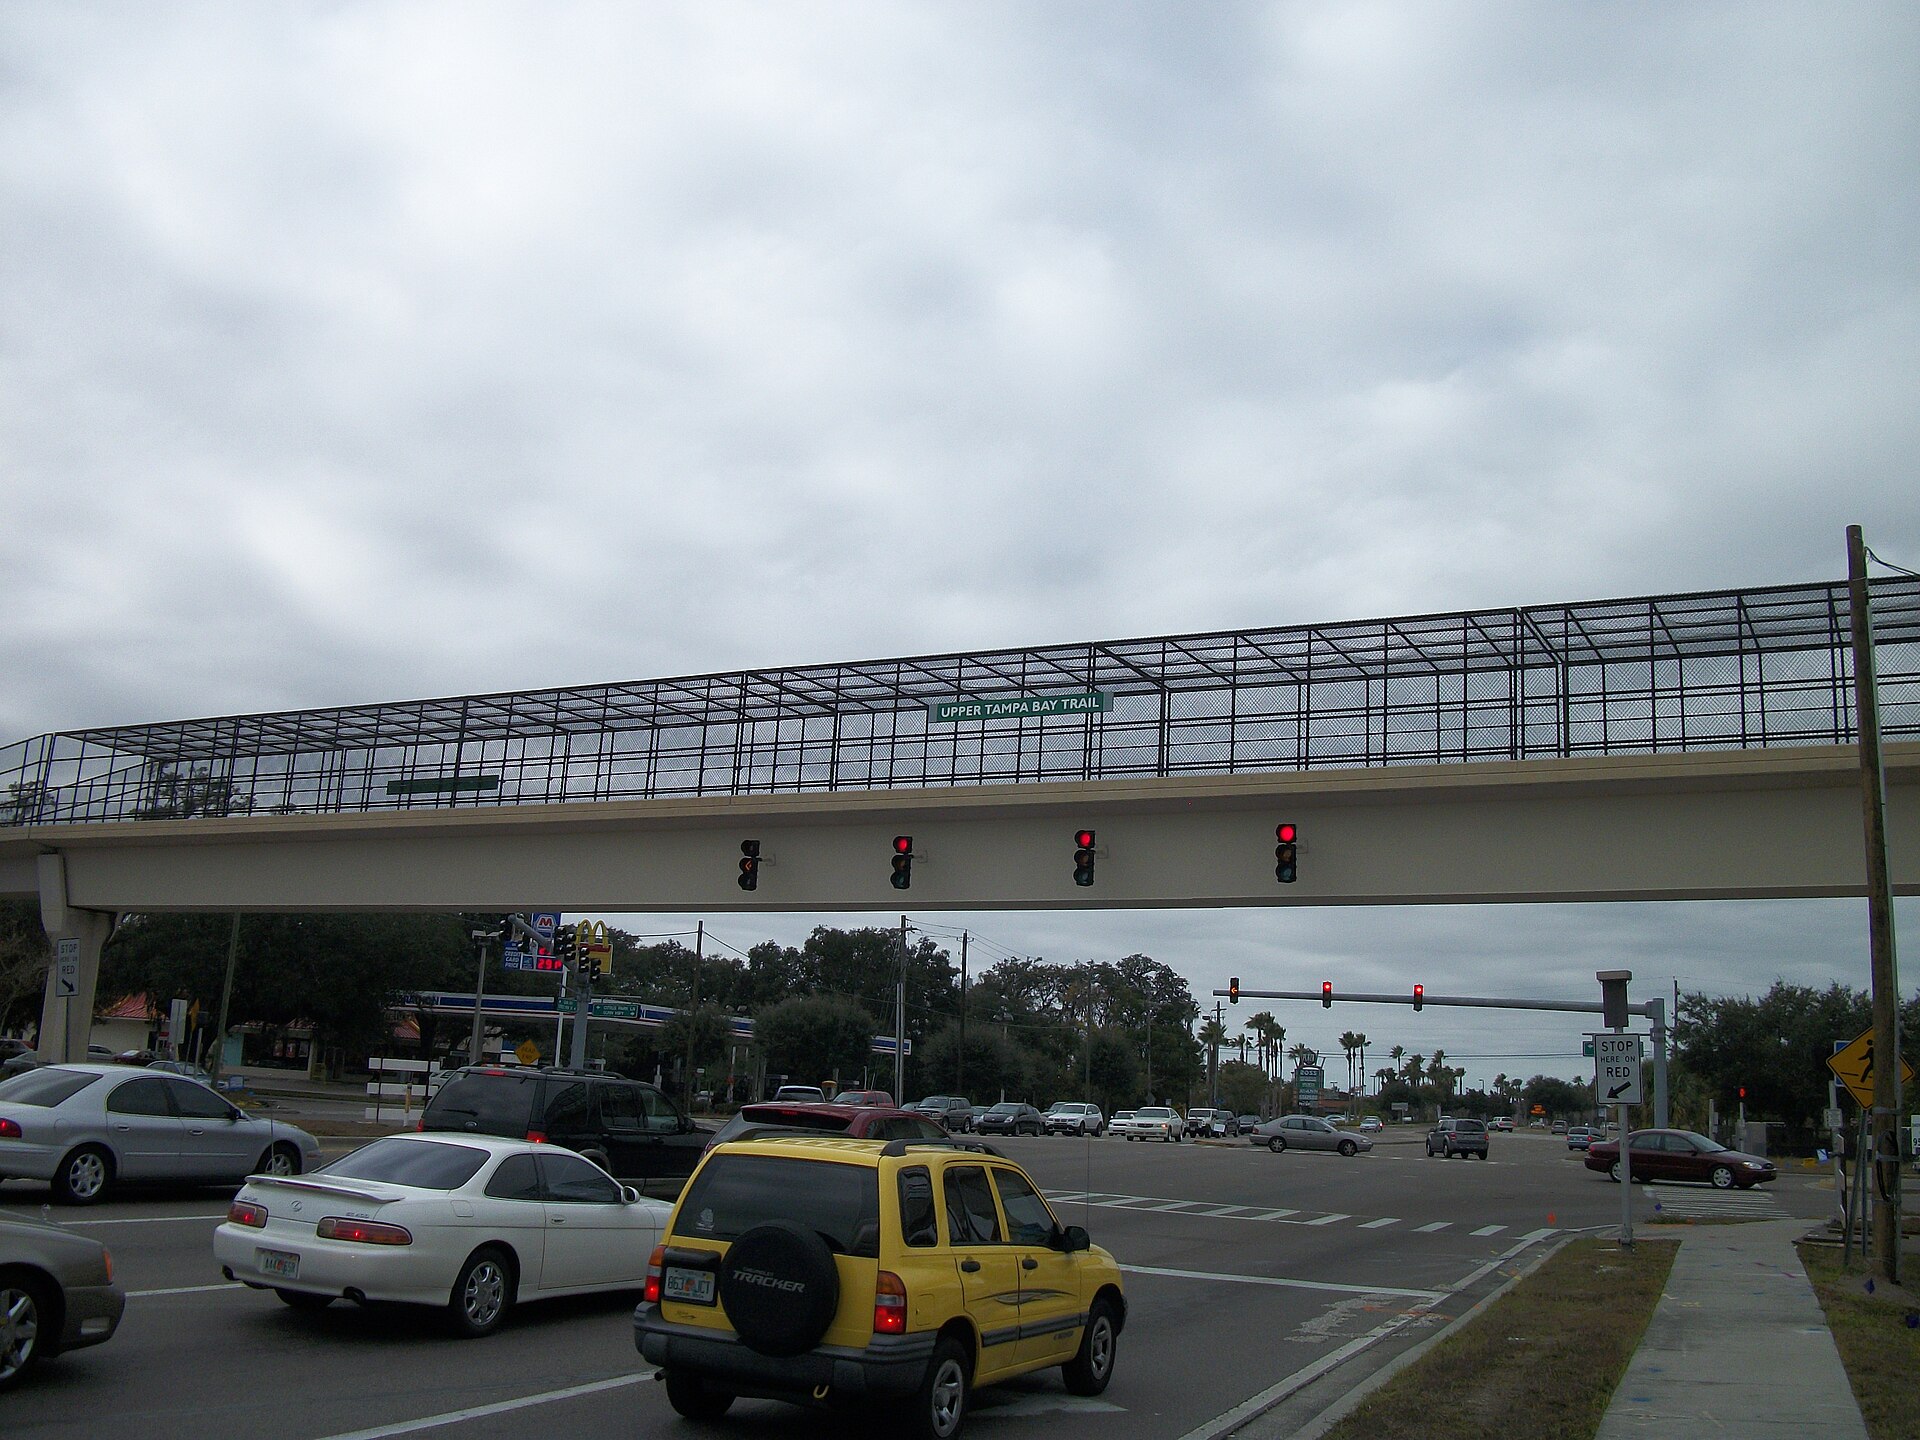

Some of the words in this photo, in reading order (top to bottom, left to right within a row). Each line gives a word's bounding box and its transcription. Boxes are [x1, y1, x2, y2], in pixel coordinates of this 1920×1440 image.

[941, 704, 982, 718] UPPER
[984, 701, 1029, 716] TAMPA
[1032, 699, 1058, 713] BAY
[1061, 696, 1100, 711] TRAIL
[60, 943, 77, 954] STOP
[61, 965, 76, 975] RED
[1601, 1041, 1634, 1052] STOP
[1600, 1055, 1620, 1063] HERE
[1624, 1055, 1636, 1063] ON
[1606, 1066, 1630, 1078] RED
[733, 1269, 806, 1294] TRACKER
